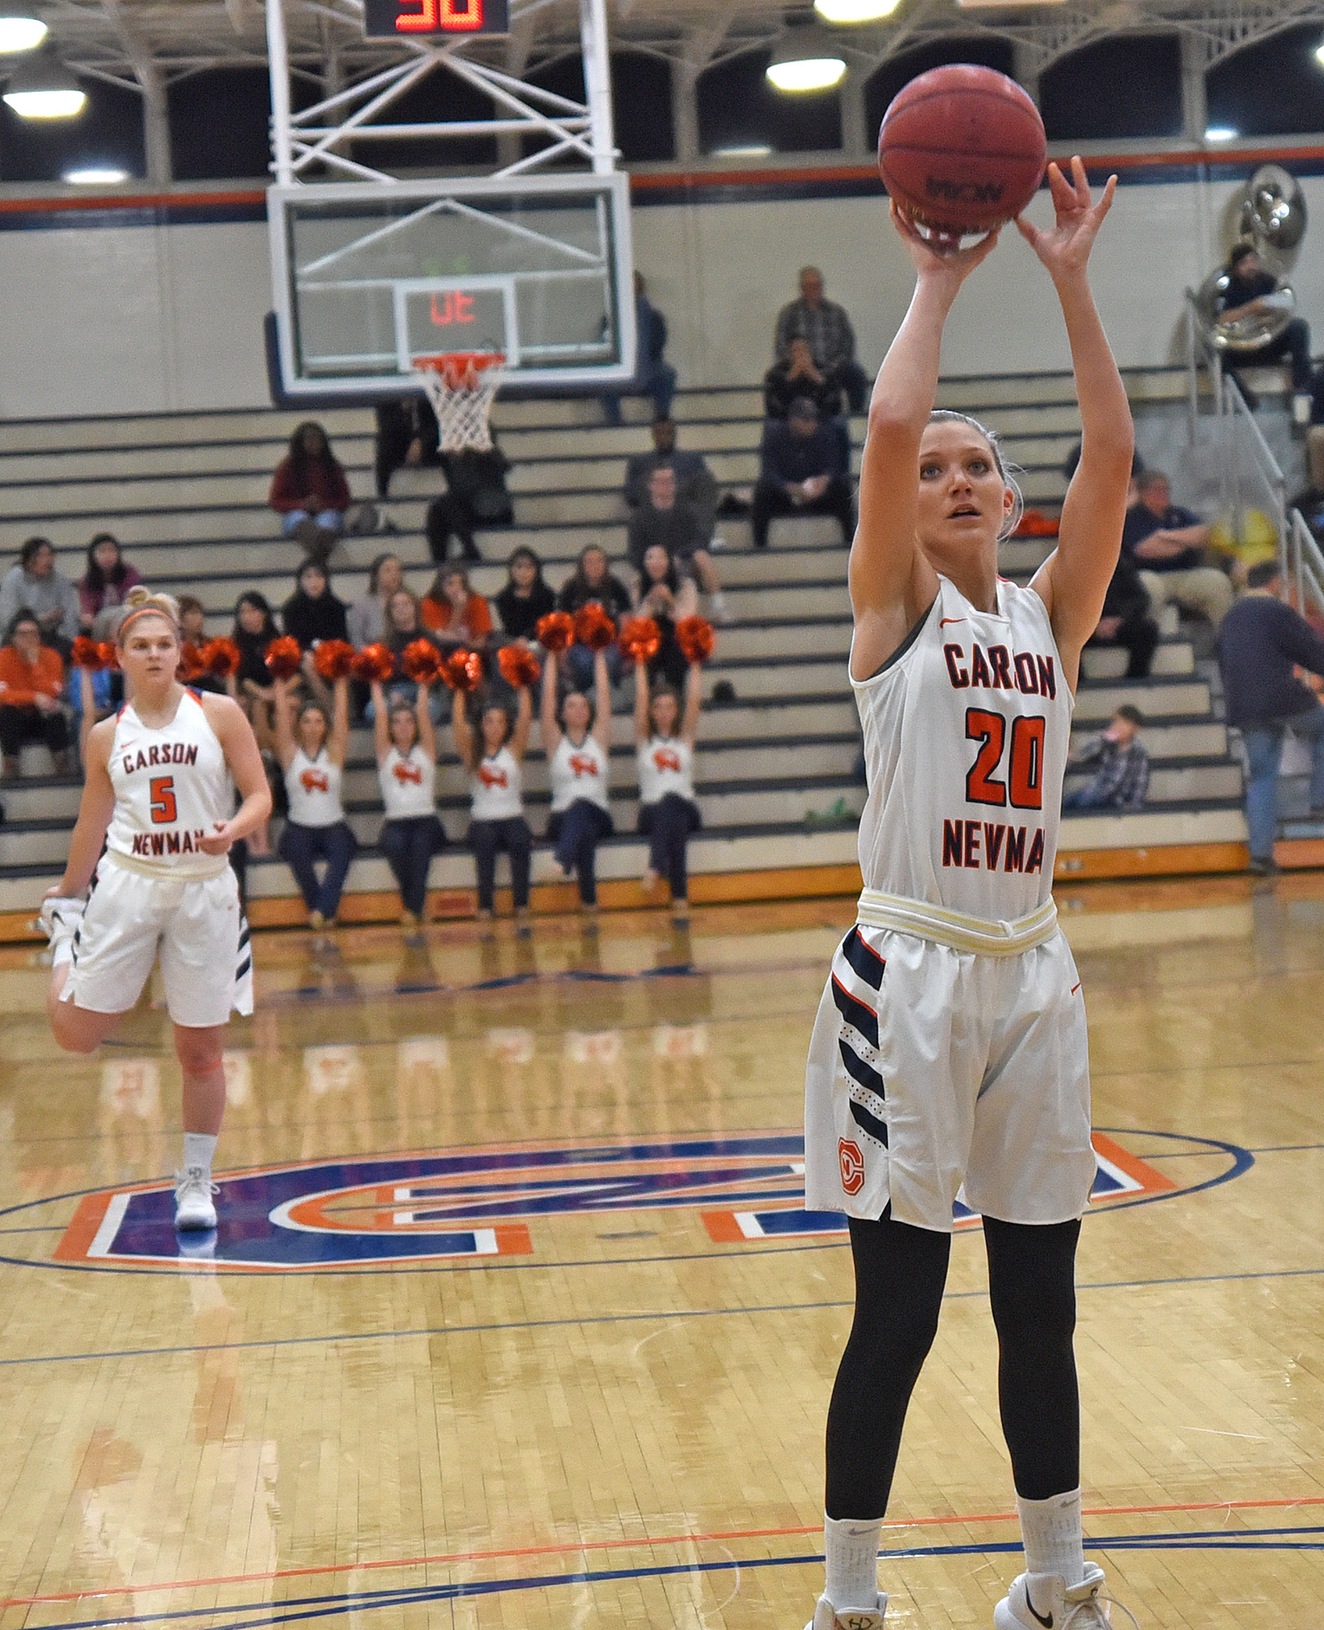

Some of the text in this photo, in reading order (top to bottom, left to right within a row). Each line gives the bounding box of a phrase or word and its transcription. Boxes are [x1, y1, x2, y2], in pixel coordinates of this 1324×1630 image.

[943, 643, 1057, 700] CARON
[123, 743, 198, 774] CARSON
[965, 707, 1046, 810] 20
[149, 775, 177, 824] 5
